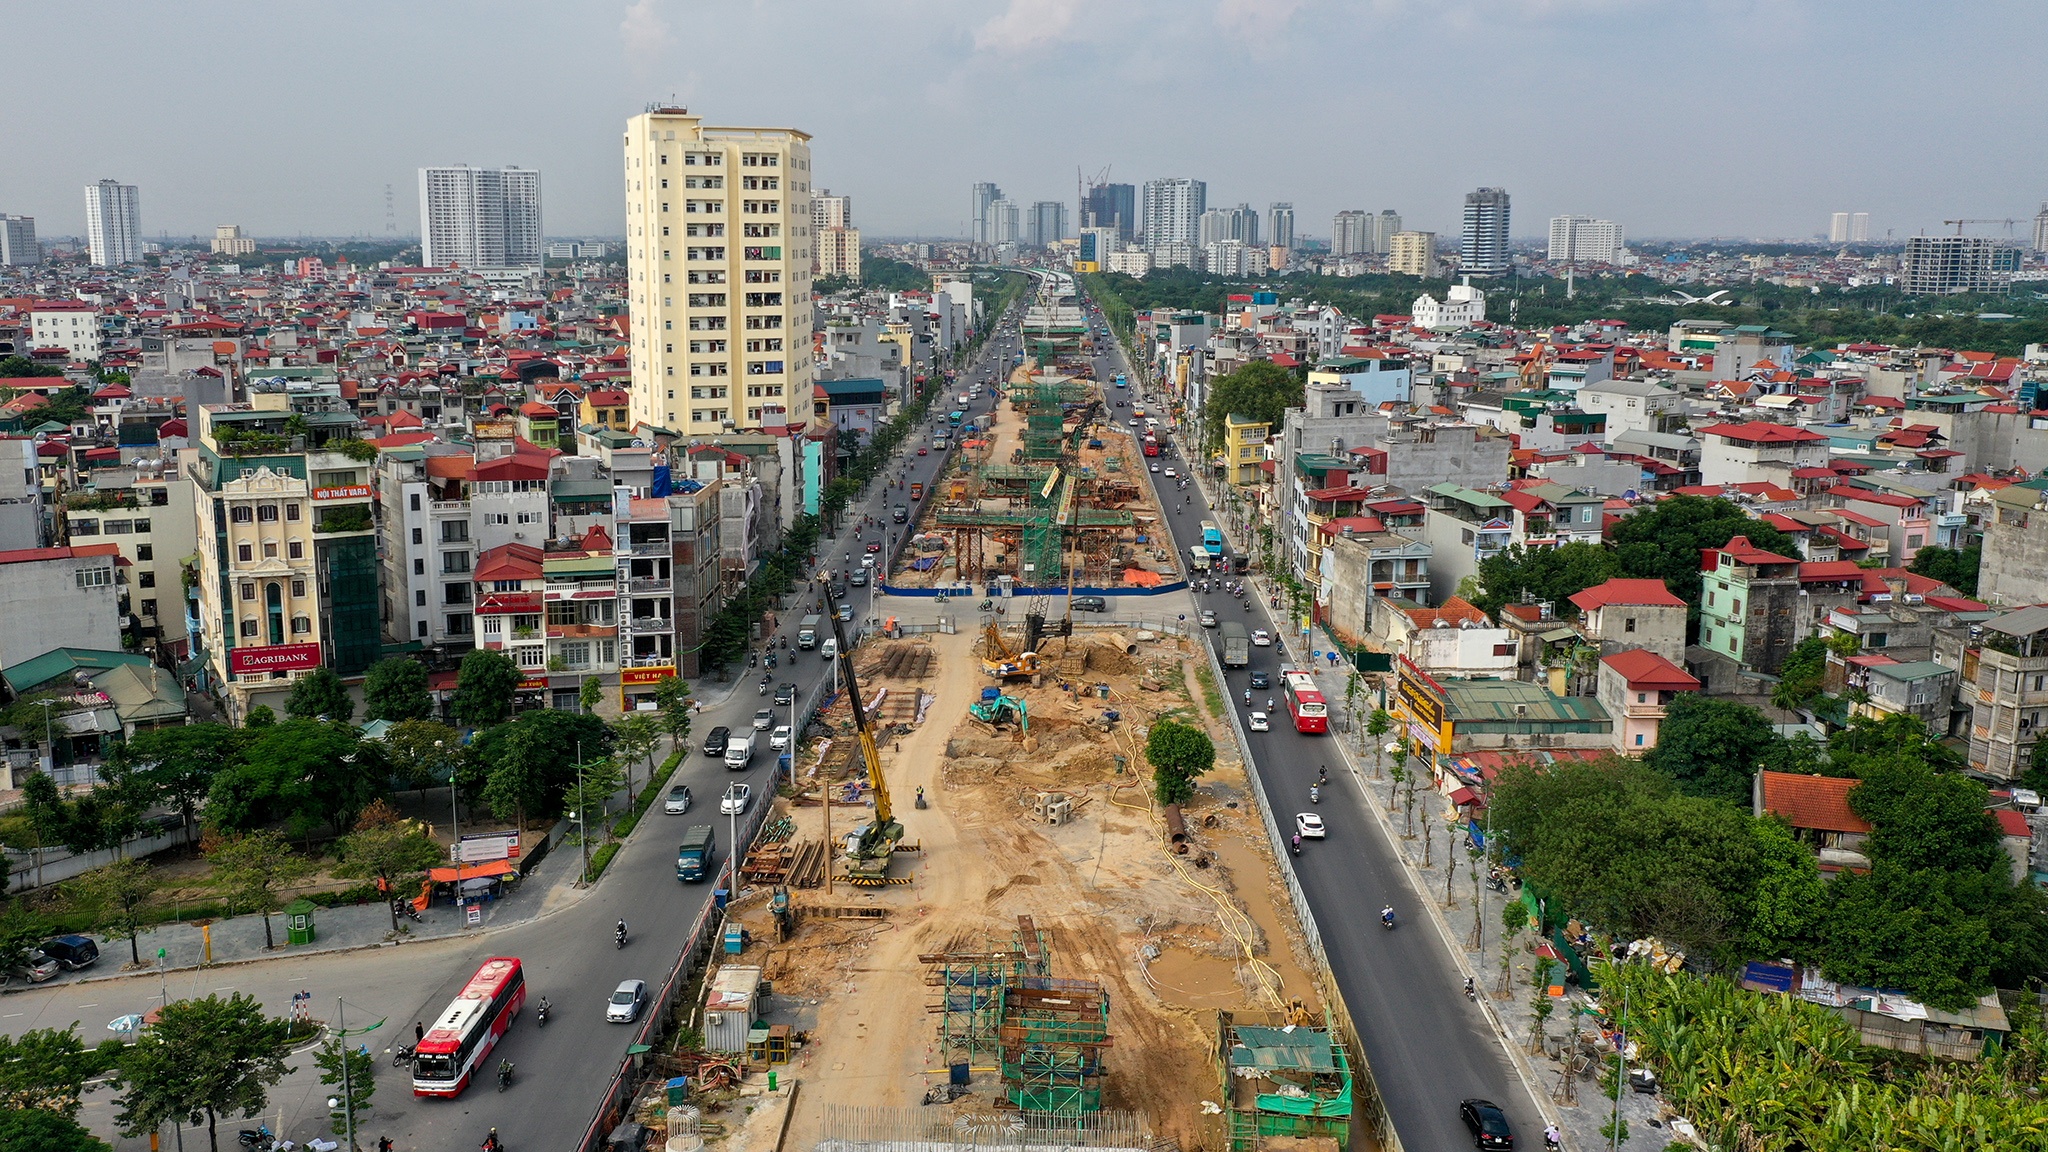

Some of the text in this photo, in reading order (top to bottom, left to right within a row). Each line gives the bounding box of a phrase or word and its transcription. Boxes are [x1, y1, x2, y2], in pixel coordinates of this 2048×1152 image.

[317, 487, 367, 499] NỘI THẤT VARA
[254, 653, 308, 665] AGRIBANK
